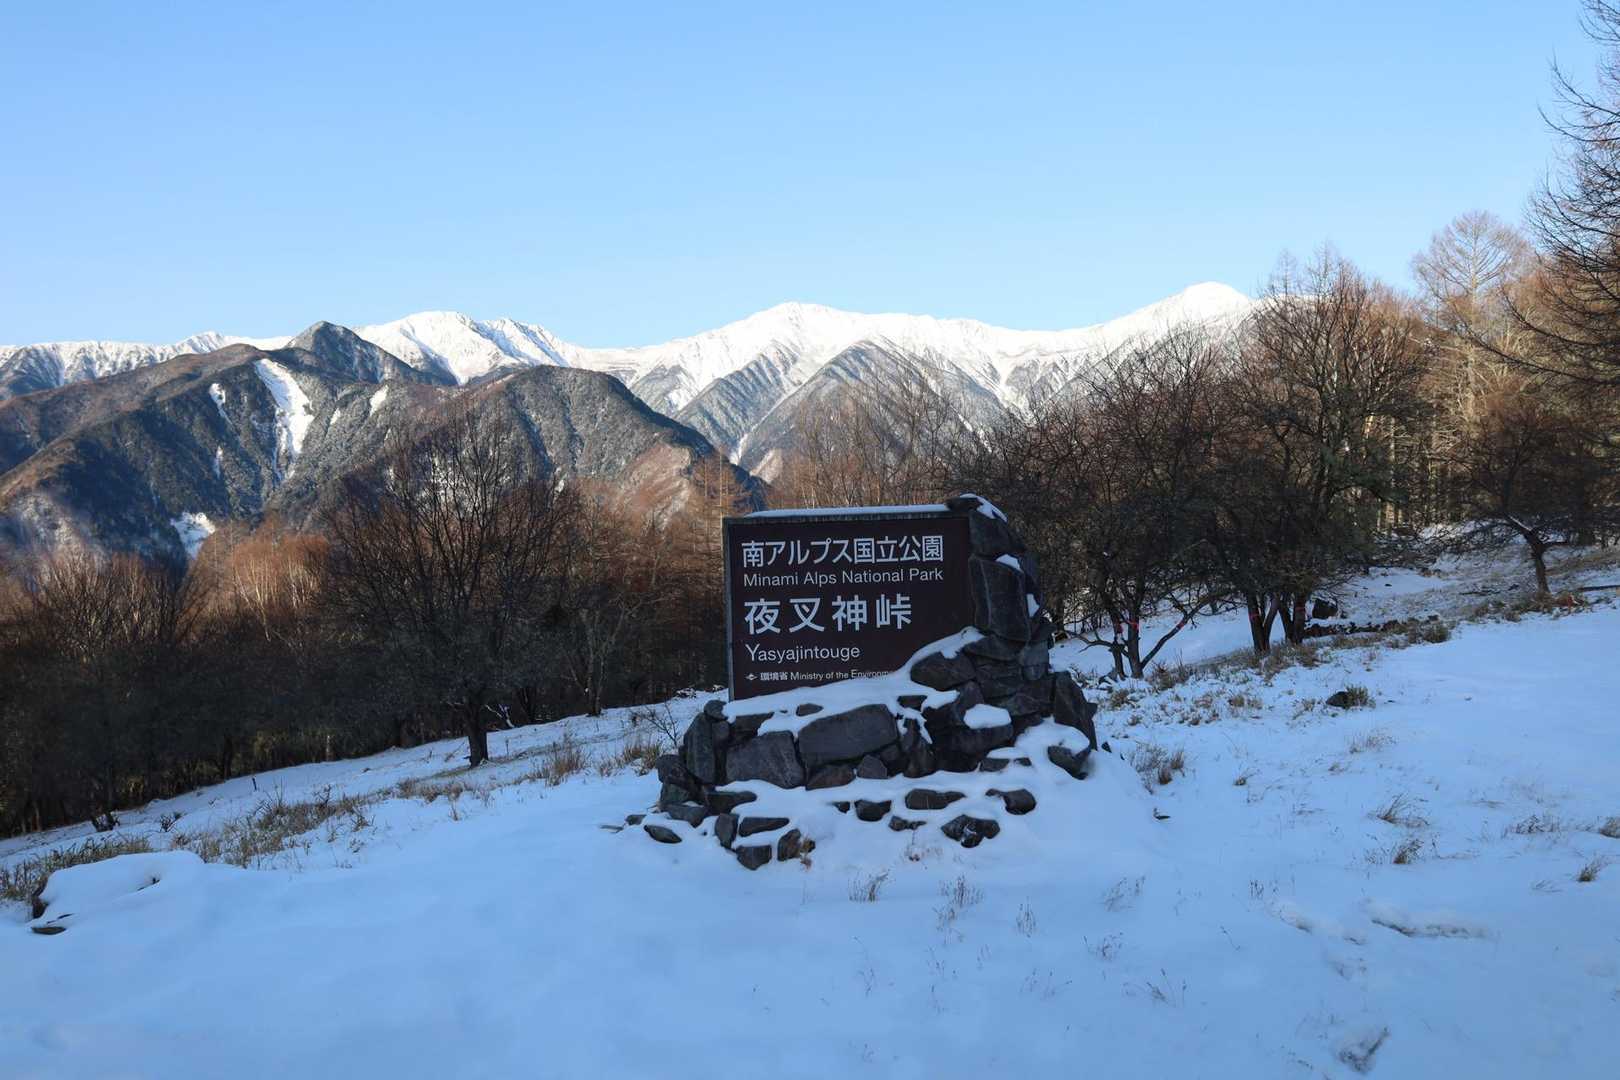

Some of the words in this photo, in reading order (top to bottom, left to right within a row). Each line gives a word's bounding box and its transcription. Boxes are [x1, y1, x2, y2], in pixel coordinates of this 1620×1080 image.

[742, 535, 944, 568] 南アルプス国立公園
[744, 573, 799, 587] Minami
[804, 571, 837, 588] Alps
[842, 569, 904, 584] National
[909, 567, 944, 581] Park
[744, 593, 912, 635] 夜叉神峠
[745, 643, 861, 664] Yasyajintouge
[790, 671, 824, 682] Ministry
[825, 671, 835, 680] of
[835, 671, 849, 679] the
